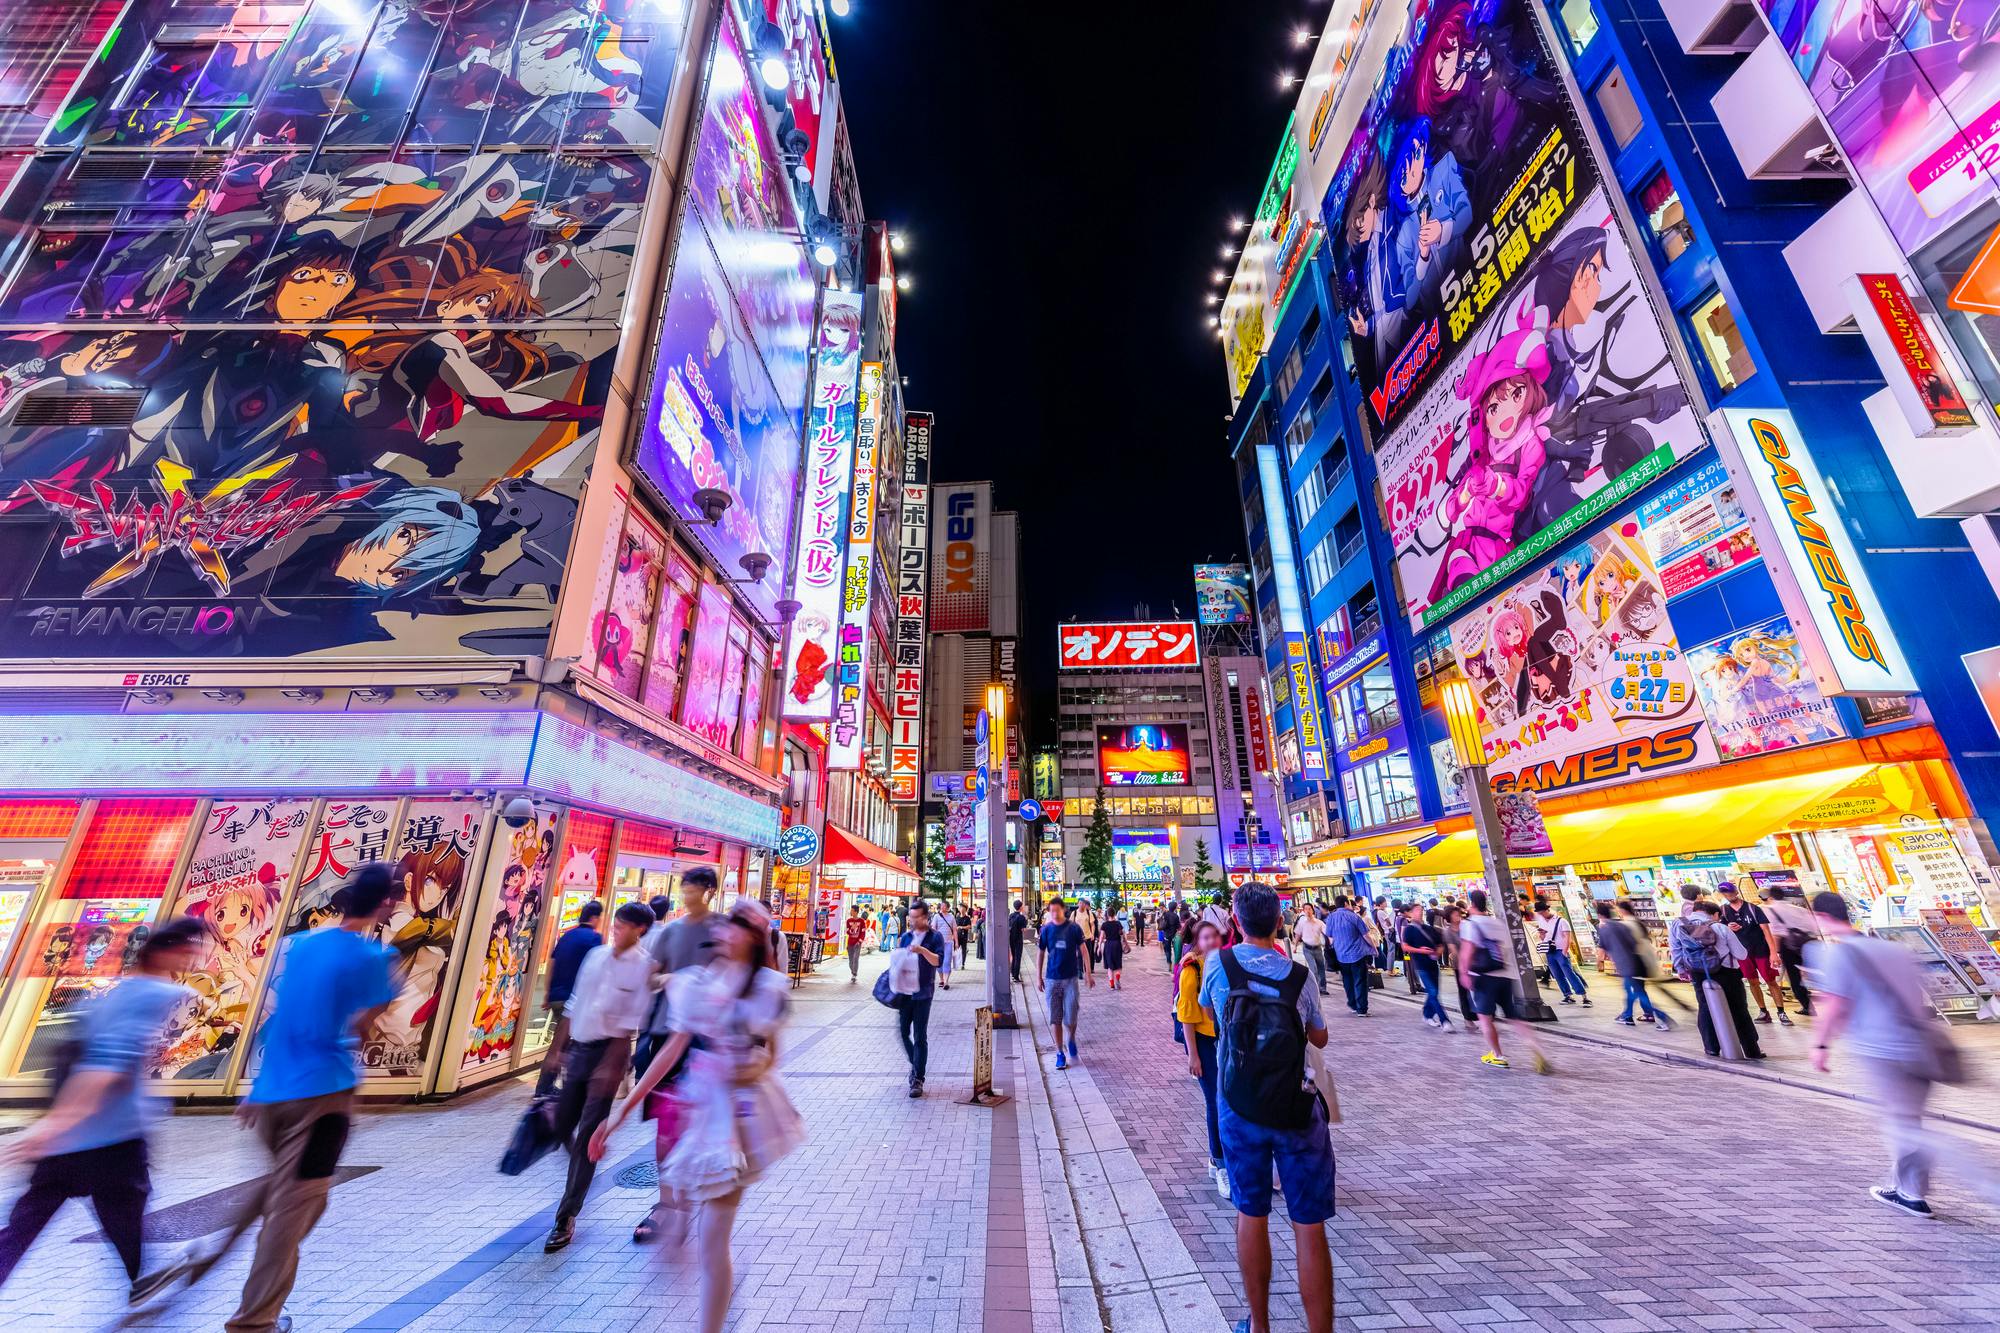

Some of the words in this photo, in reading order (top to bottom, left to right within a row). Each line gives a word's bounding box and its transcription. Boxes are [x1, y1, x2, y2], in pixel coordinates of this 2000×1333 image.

[1440, 142, 1569, 312] 5月5日(土)より
[1448, 155, 1576, 343] 放送開始!
[1371, 317, 1440, 426] Vanguard
[857, 418, 876, 461] 買取り
[917, 418, 928, 461] HOBBY
[1381, 368, 1468, 474] ガンゲイル・オンライン
[1430, 420, 1453, 451] 第1巻
[904, 418, 918, 482] PARADISE
[805, 382, 847, 585] ガールフレンド(仮)
[1391, 453, 1439, 528] 6.22
[851, 482, 873, 536] まっくす
[1396, 522, 1411, 545] ON
[1410, 502, 1434, 532] SALE
[1747, 417, 1893, 678] GAMERS
[1426, 585, 1471, 622] Blu-ray&DVD
[1000, 641, 1016, 672] Duty
[1062, 627, 1193, 661] オノデン
[140, 674, 191, 686] ESPACE
[835, 623, 864, 748] とれじゃらす
[1610, 677, 1686, 703] 6月27日
[1625, 663, 1663, 677] 第1巻
[1625, 702, 1640, 711] ON
[1641, 703, 1665, 714] SALE
[1489, 719, 1705, 794] GAMERS
[783, 825, 816, 842] SMOKER'S
[190, 847, 252, 875] PACHINKO
[190, 858, 257, 887] PACHISLOT
[820, 890, 842, 901] 本日
[1936, 931, 1977, 939] EXCHANGE
[362, 1042, 418, 1068] Gate
